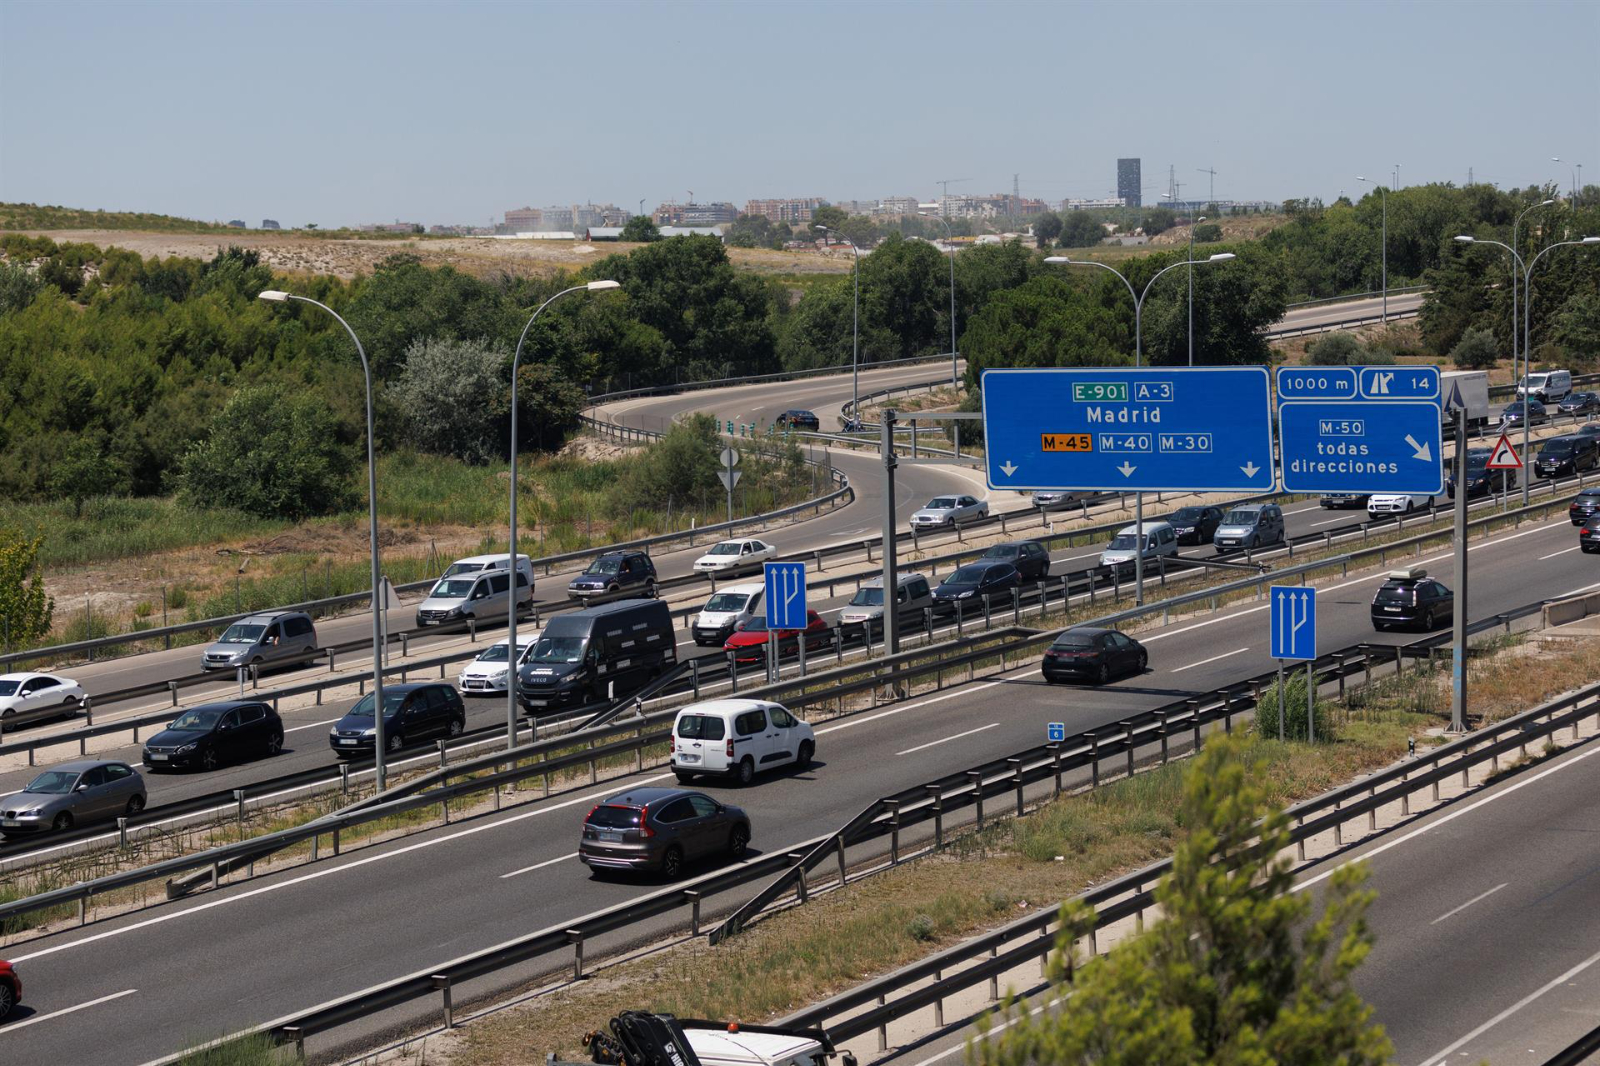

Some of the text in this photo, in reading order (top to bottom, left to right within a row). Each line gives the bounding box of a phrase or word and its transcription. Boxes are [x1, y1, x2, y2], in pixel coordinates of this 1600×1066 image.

[1287, 378, 1348, 389] 1000 m
[1412, 377, 1429, 389] 14
[1075, 385, 1170, 399] E-901 A-3
[1087, 406, 1161, 423] Madrid
[1321, 422, 1362, 434] M-50
[1043, 436, 1209, 450] M-45 M-40 M-30
[1317, 442, 1369, 455] todas
[1291, 459, 1398, 473] direcciones
